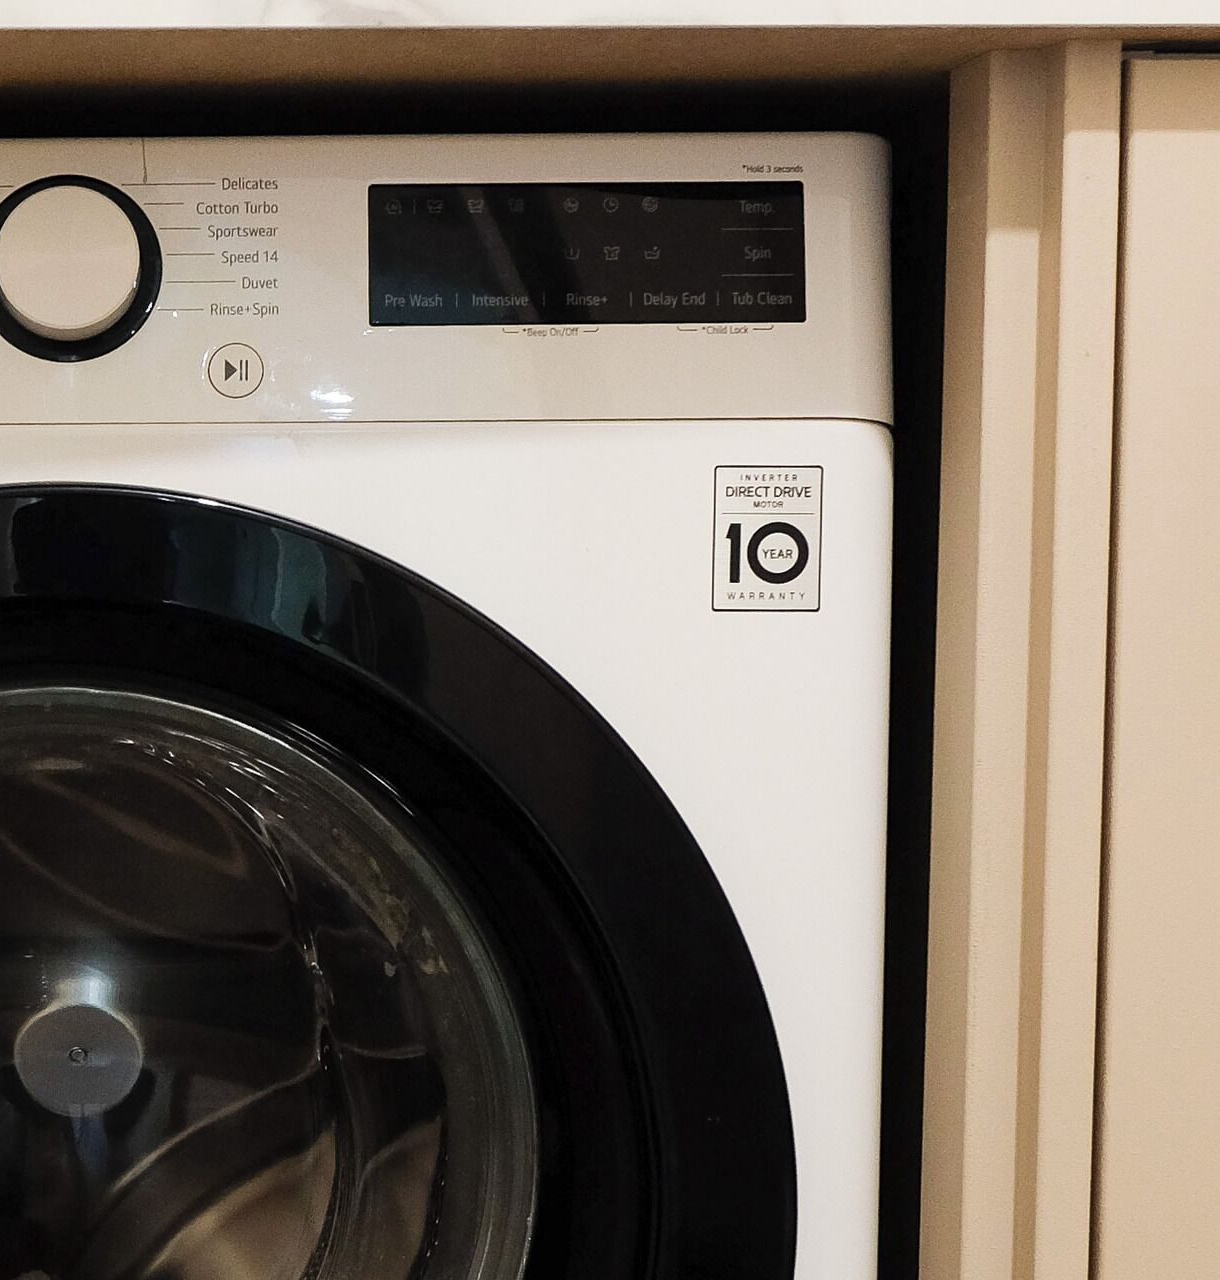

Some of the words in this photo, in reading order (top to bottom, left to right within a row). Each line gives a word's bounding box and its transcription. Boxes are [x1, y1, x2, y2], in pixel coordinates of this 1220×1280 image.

[765, 165, 772, 173] 3
[221, 177, 279, 191] Delicates
[196, 202, 240, 215] Cotton
[243, 201, 279, 214] Turbo
[739, 200, 776, 216] Temp.
[207, 225, 279, 240] Sportswear
[221, 251, 259, 266] Speed
[263, 250, 279, 263] 14
[744, 246, 772, 262] Spin
[242, 277, 279, 289] Duvet
[384, 294, 406, 308] Pre
[410, 292, 444, 308] Wash
[472, 293, 530, 307] Intensive
[566, 293, 609, 306] Rinse+
[643, 292, 678, 309] Delay
[682, 292, 706, 306] End
[732, 291, 754, 306] Tub
[757, 291, 793, 306] Clean
[549, 327, 580, 337] On/Off
[729, 326, 749, 334] Lock
[725, 486, 770, 498] DIRECT
[773, 486, 812, 498] DRIVE
[725, 521, 809, 584] 10
[762, 549, 793, 559] YEAR
[726, 592, 806, 600] WARRANTY
